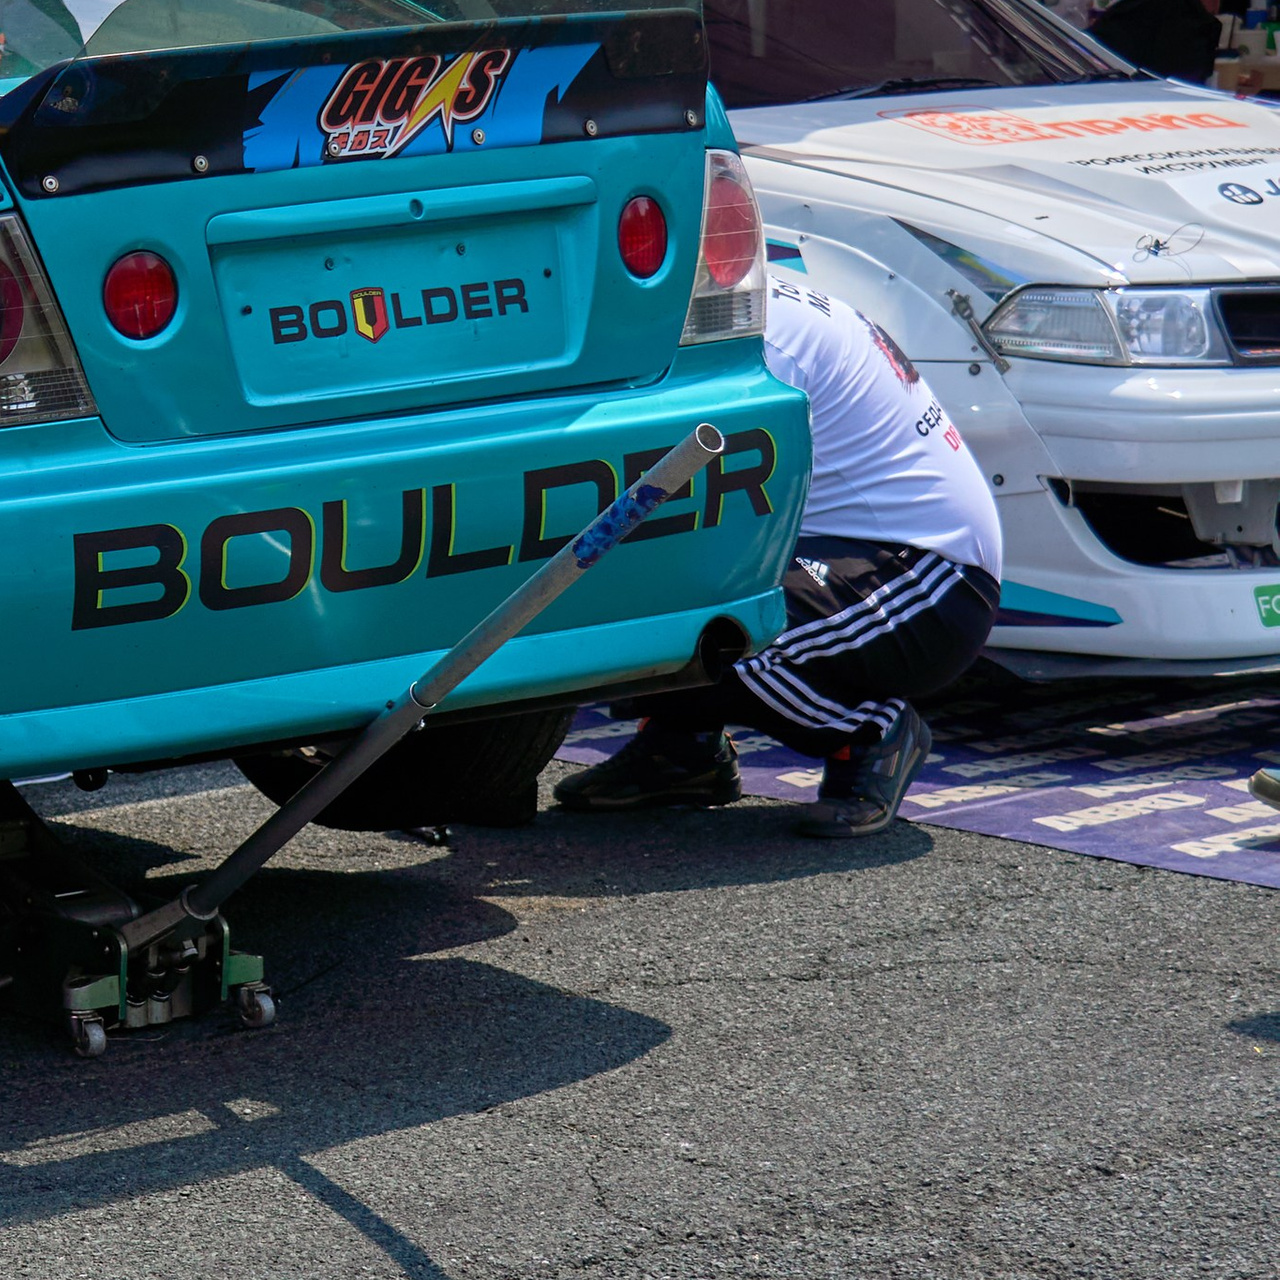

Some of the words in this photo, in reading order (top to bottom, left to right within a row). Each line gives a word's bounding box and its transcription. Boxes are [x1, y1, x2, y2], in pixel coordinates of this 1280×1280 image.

[1135, 157, 1269, 175] ИНСТРУМЕНТ
[269, 277, 529, 345] BOULDER
[72, 427, 777, 630] BOULDER
[795, 556, 826, 587] adidas
[1031, 791, 1206, 832] ABRO
